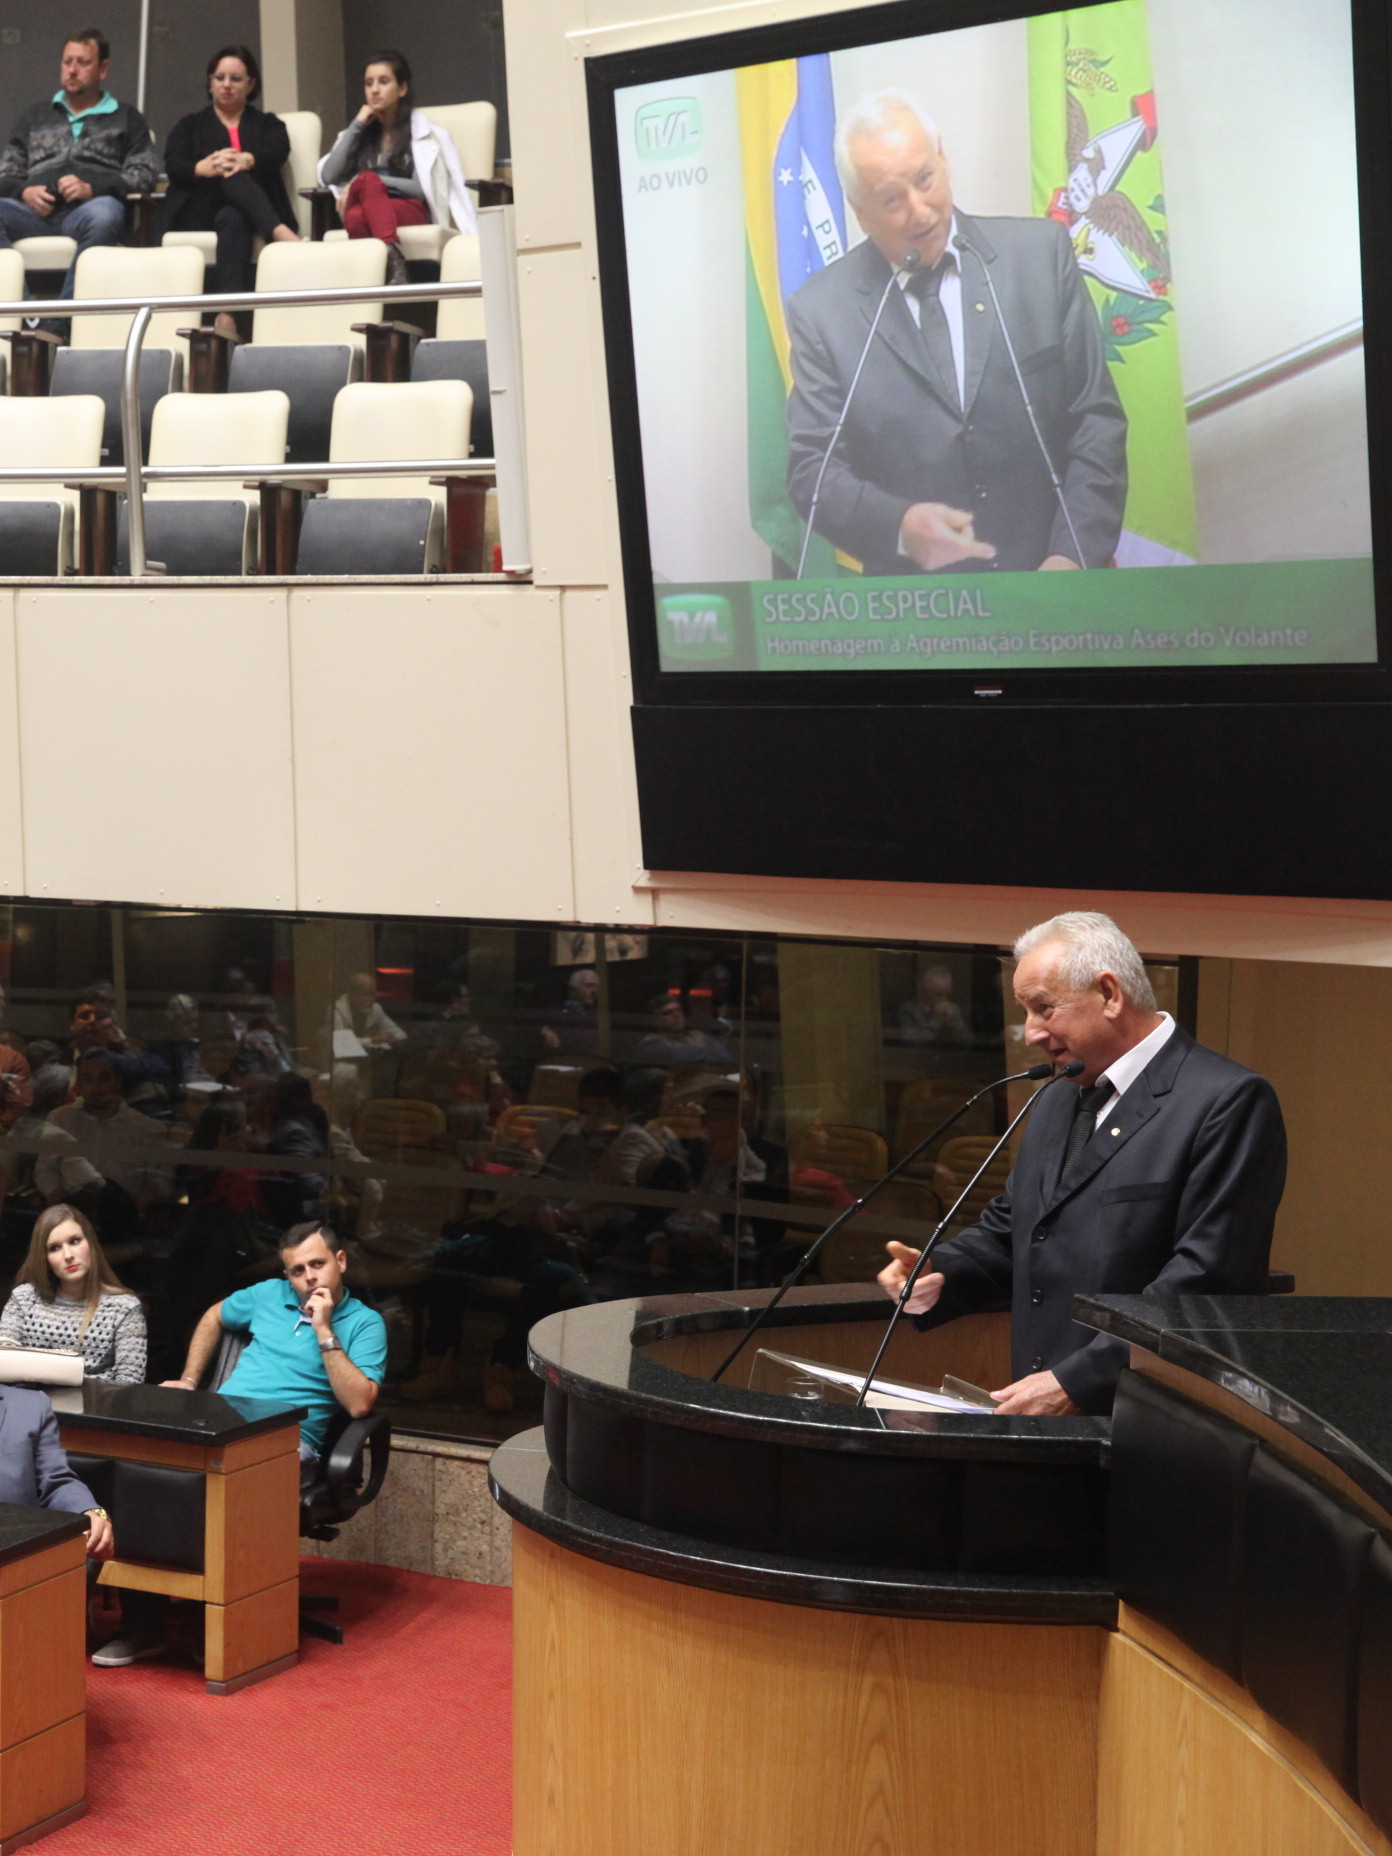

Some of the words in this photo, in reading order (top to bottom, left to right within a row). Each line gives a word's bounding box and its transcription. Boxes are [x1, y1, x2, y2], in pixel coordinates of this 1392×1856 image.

[637, 173, 661, 193] AO
[664, 166, 708, 189] VIVO
[762, 587, 859, 622] SESSÃO
[867, 588, 992, 620] ESPECIAL
[766, 635, 885, 660] Homenagem
[908, 632, 1024, 658] Agremiação
[1029, 629, 1124, 657] Esportiva
[1131, 628, 1179, 650] Ases
[1186, 626, 1215, 648] do
[1220, 625, 1308, 648] Volante
